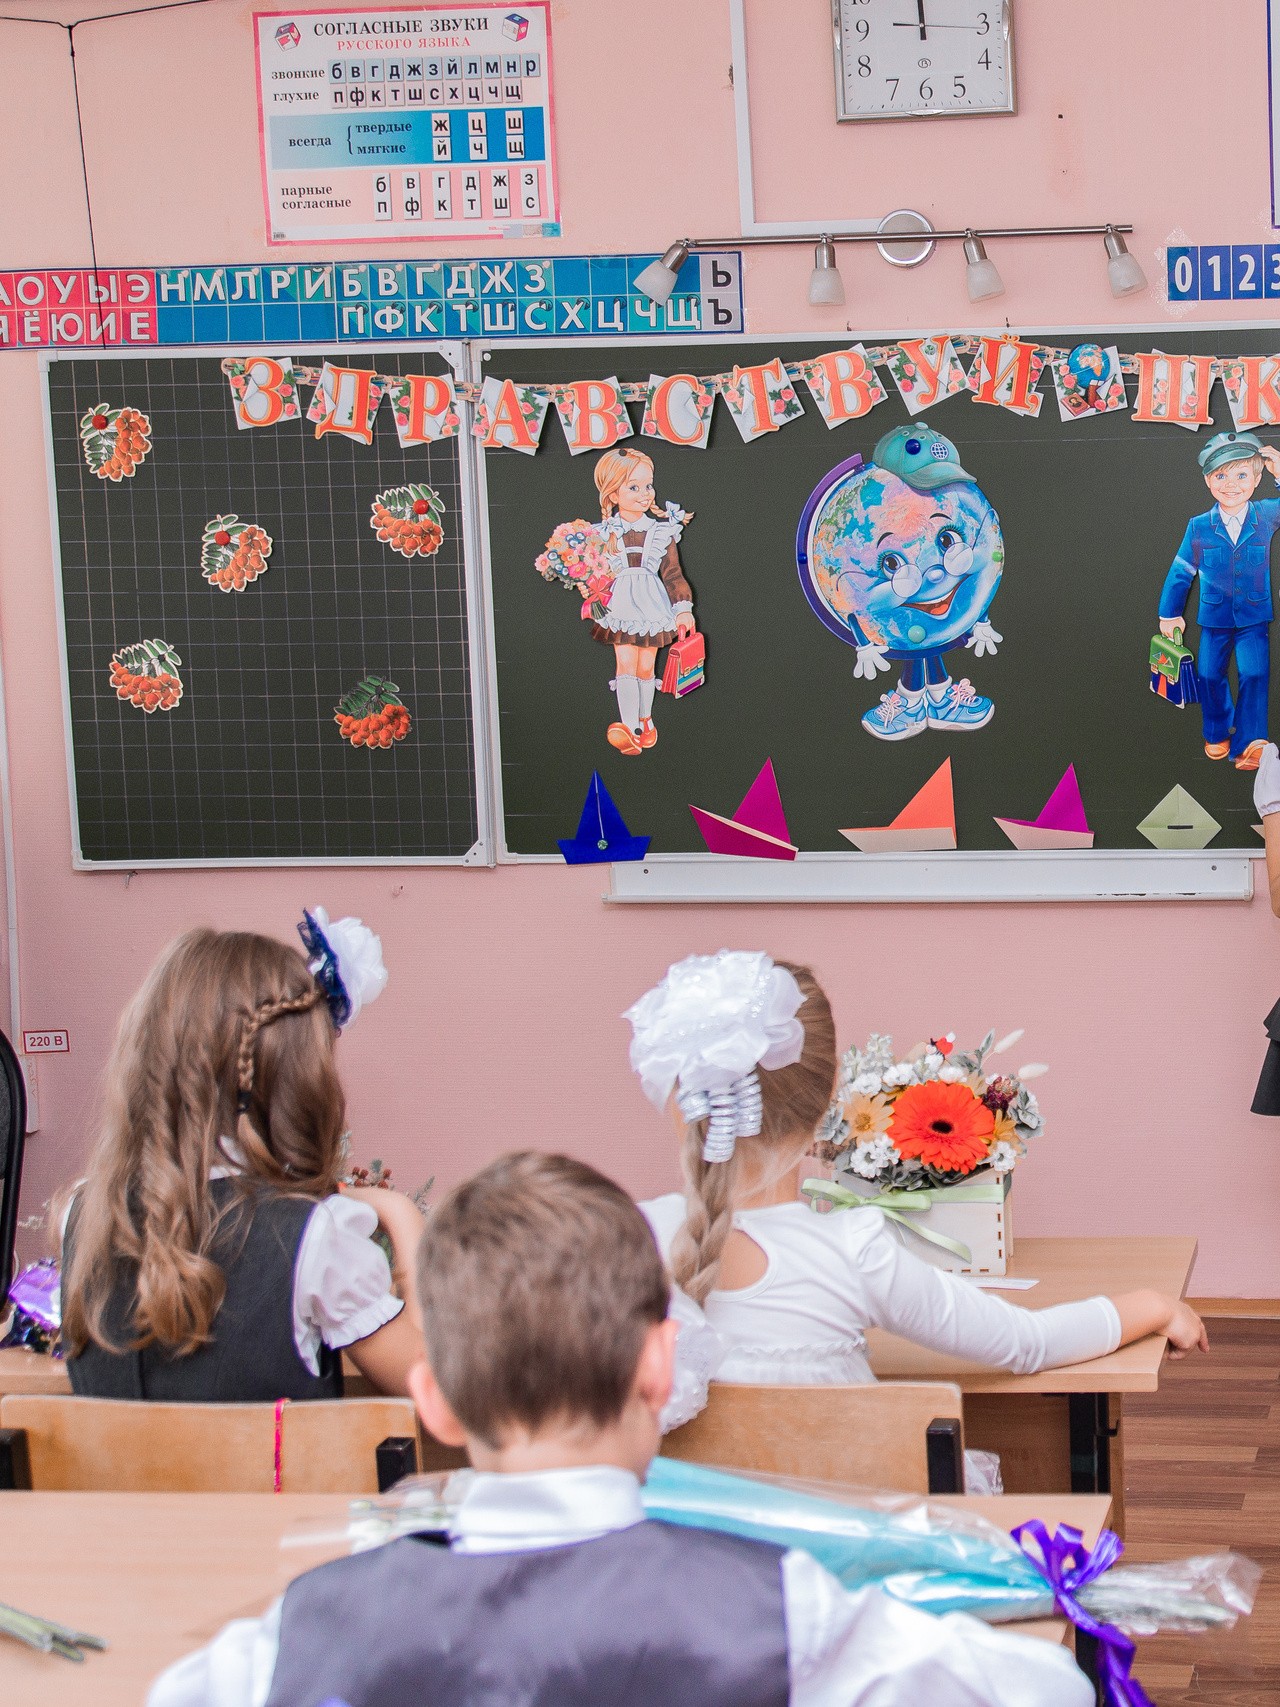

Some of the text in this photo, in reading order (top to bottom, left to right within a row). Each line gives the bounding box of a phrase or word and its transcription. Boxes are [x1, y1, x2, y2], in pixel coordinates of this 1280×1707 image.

[314, 18, 489, 36] СОГЛАСНЫЕ ЗВУКИ
[856, 13, 989, 41] 9 3
[337, 37, 471, 50] РУССКОГО ЯЗЫКА
[272, 57, 536, 80] звонкие б в г д ж з й л м н р
[858, 48, 992, 77] 8 4
[274, 85, 520, 106] глухие п ф к т ш с х ц ч щ
[886, 76, 966, 101] 7 6 5
[356, 122, 412, 134] твердые
[289, 136, 331, 149] всегда
[357, 143, 406, 155] мягкие
[282, 185, 332, 197] парные
[282, 198, 351, 210] согласные
[1175, 256, 1192, 292] 0
[1208, 256, 1221, 292] 1
[1239, 255, 1256, 291] 2
[30, 1036, 62, 1046] 220 В
